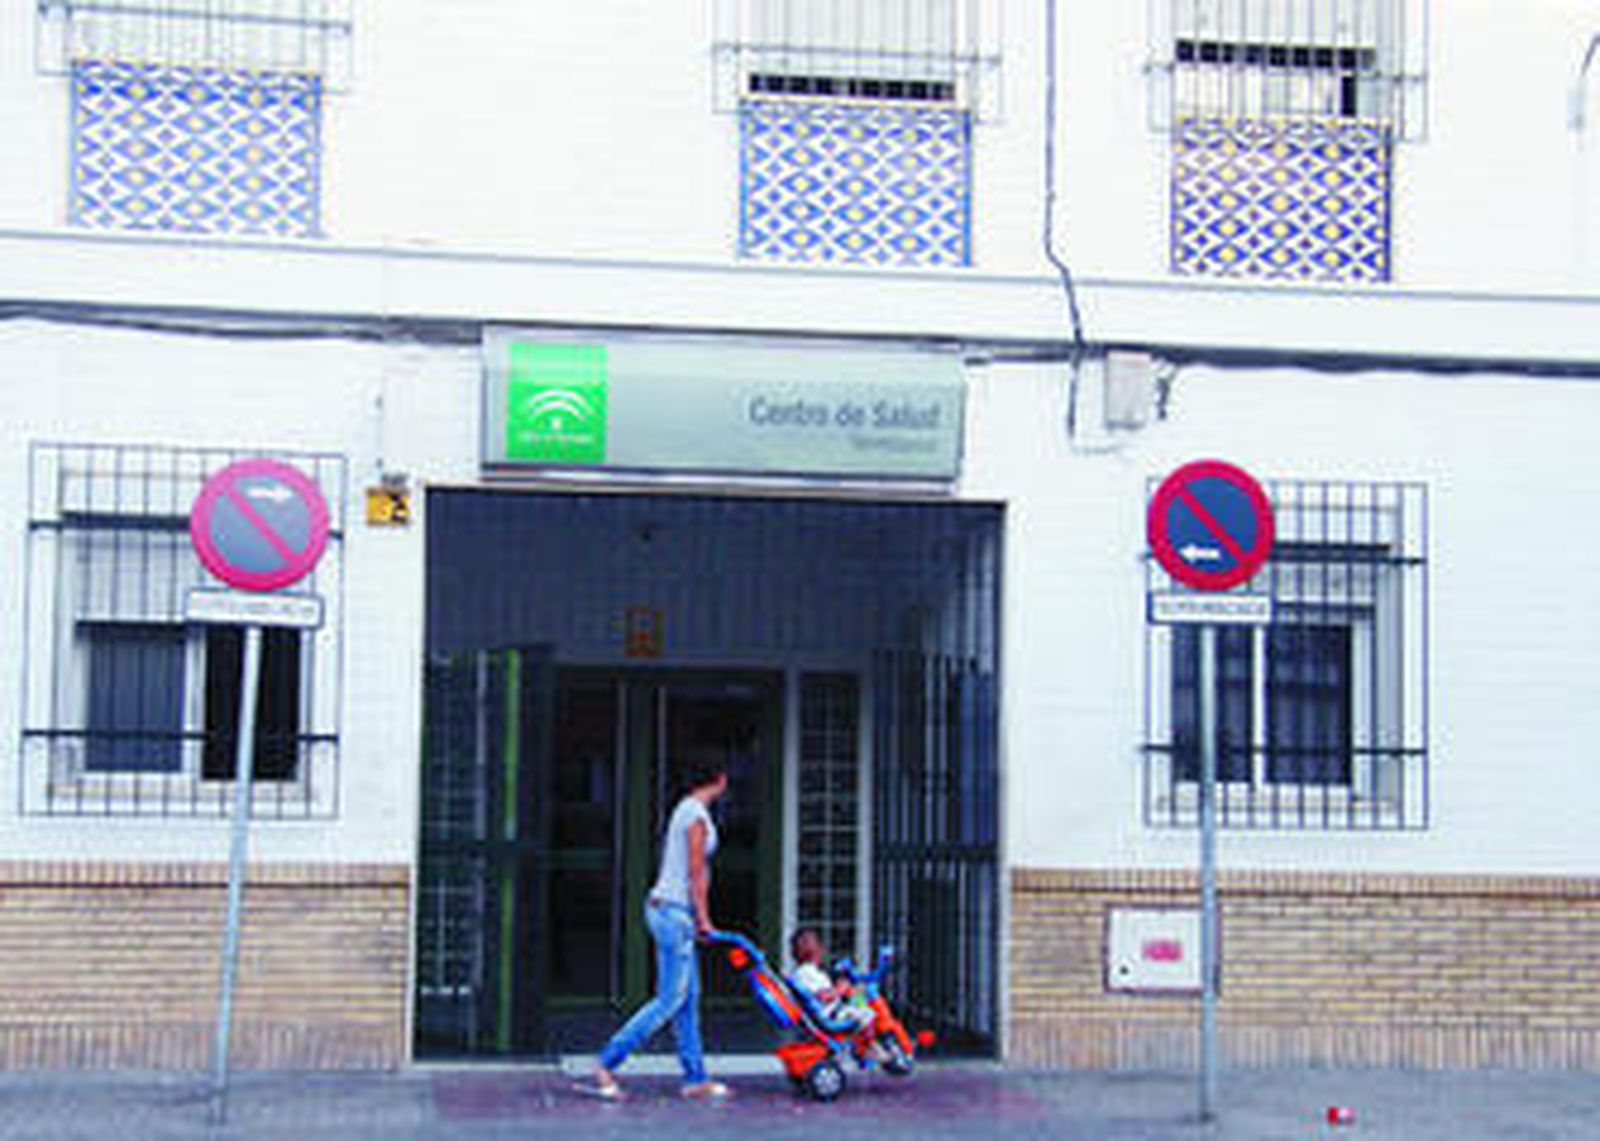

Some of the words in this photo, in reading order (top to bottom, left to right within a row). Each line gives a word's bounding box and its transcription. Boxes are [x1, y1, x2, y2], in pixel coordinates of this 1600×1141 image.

[749, 396, 829, 426] Centro
[835, 401, 866, 427] de
[871, 399, 941, 430] Salud
